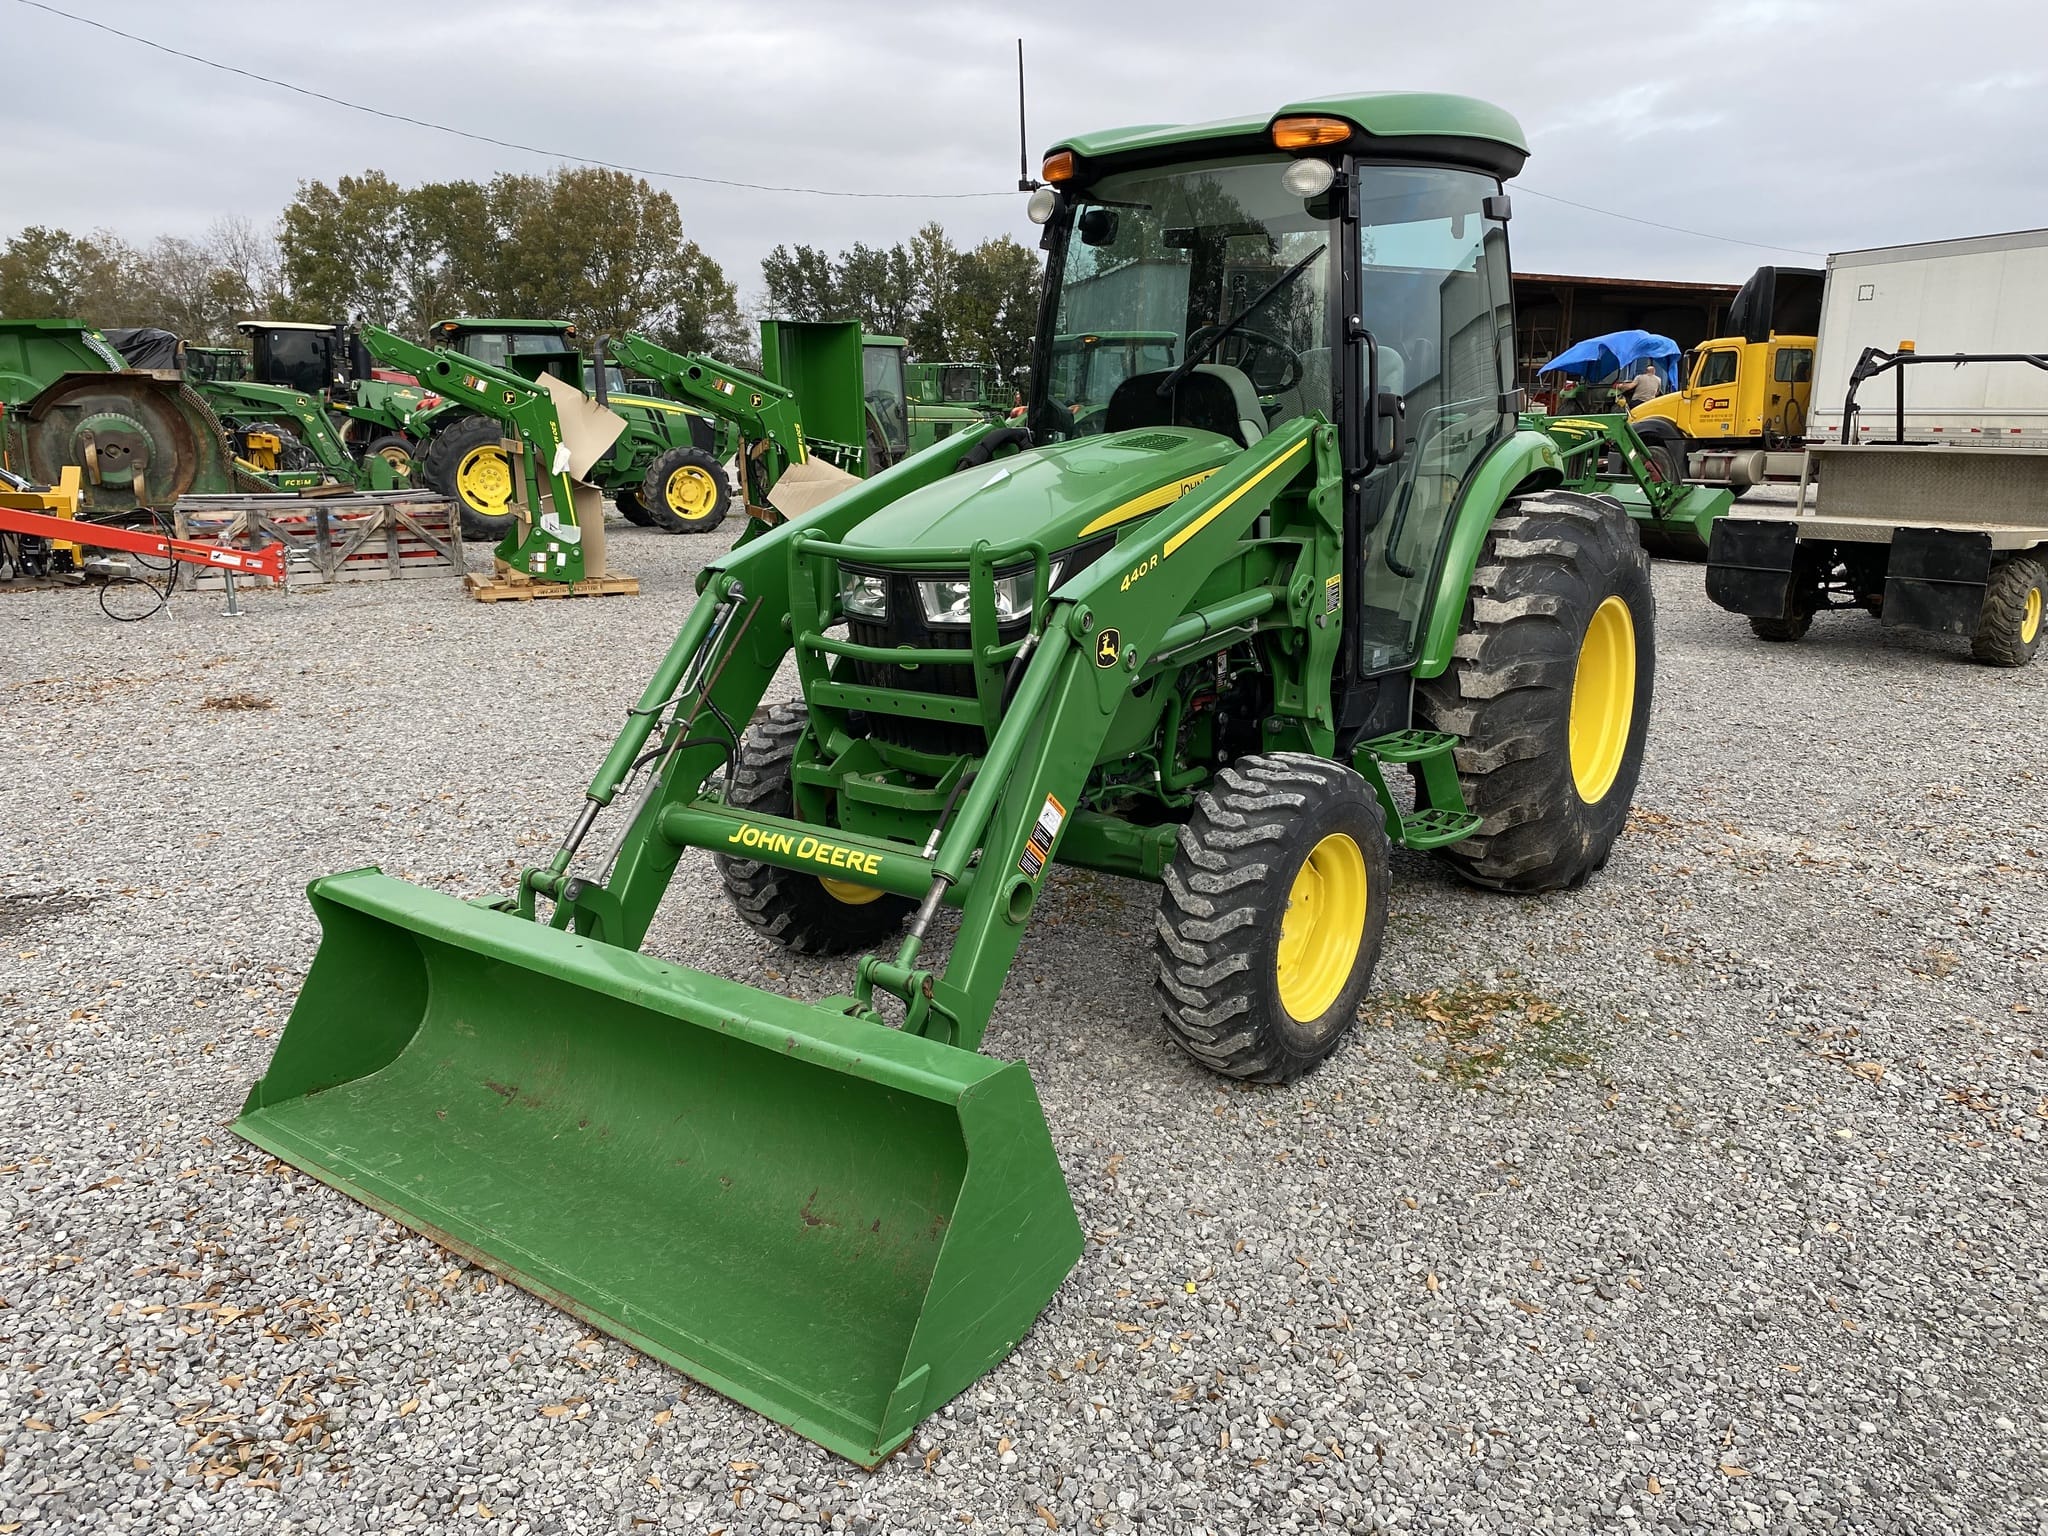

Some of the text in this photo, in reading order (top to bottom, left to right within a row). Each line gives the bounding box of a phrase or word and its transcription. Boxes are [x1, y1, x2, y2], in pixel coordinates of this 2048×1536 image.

[1120, 553, 1158, 592] 440 R
[728, 823, 884, 875] JOHN DEERE
